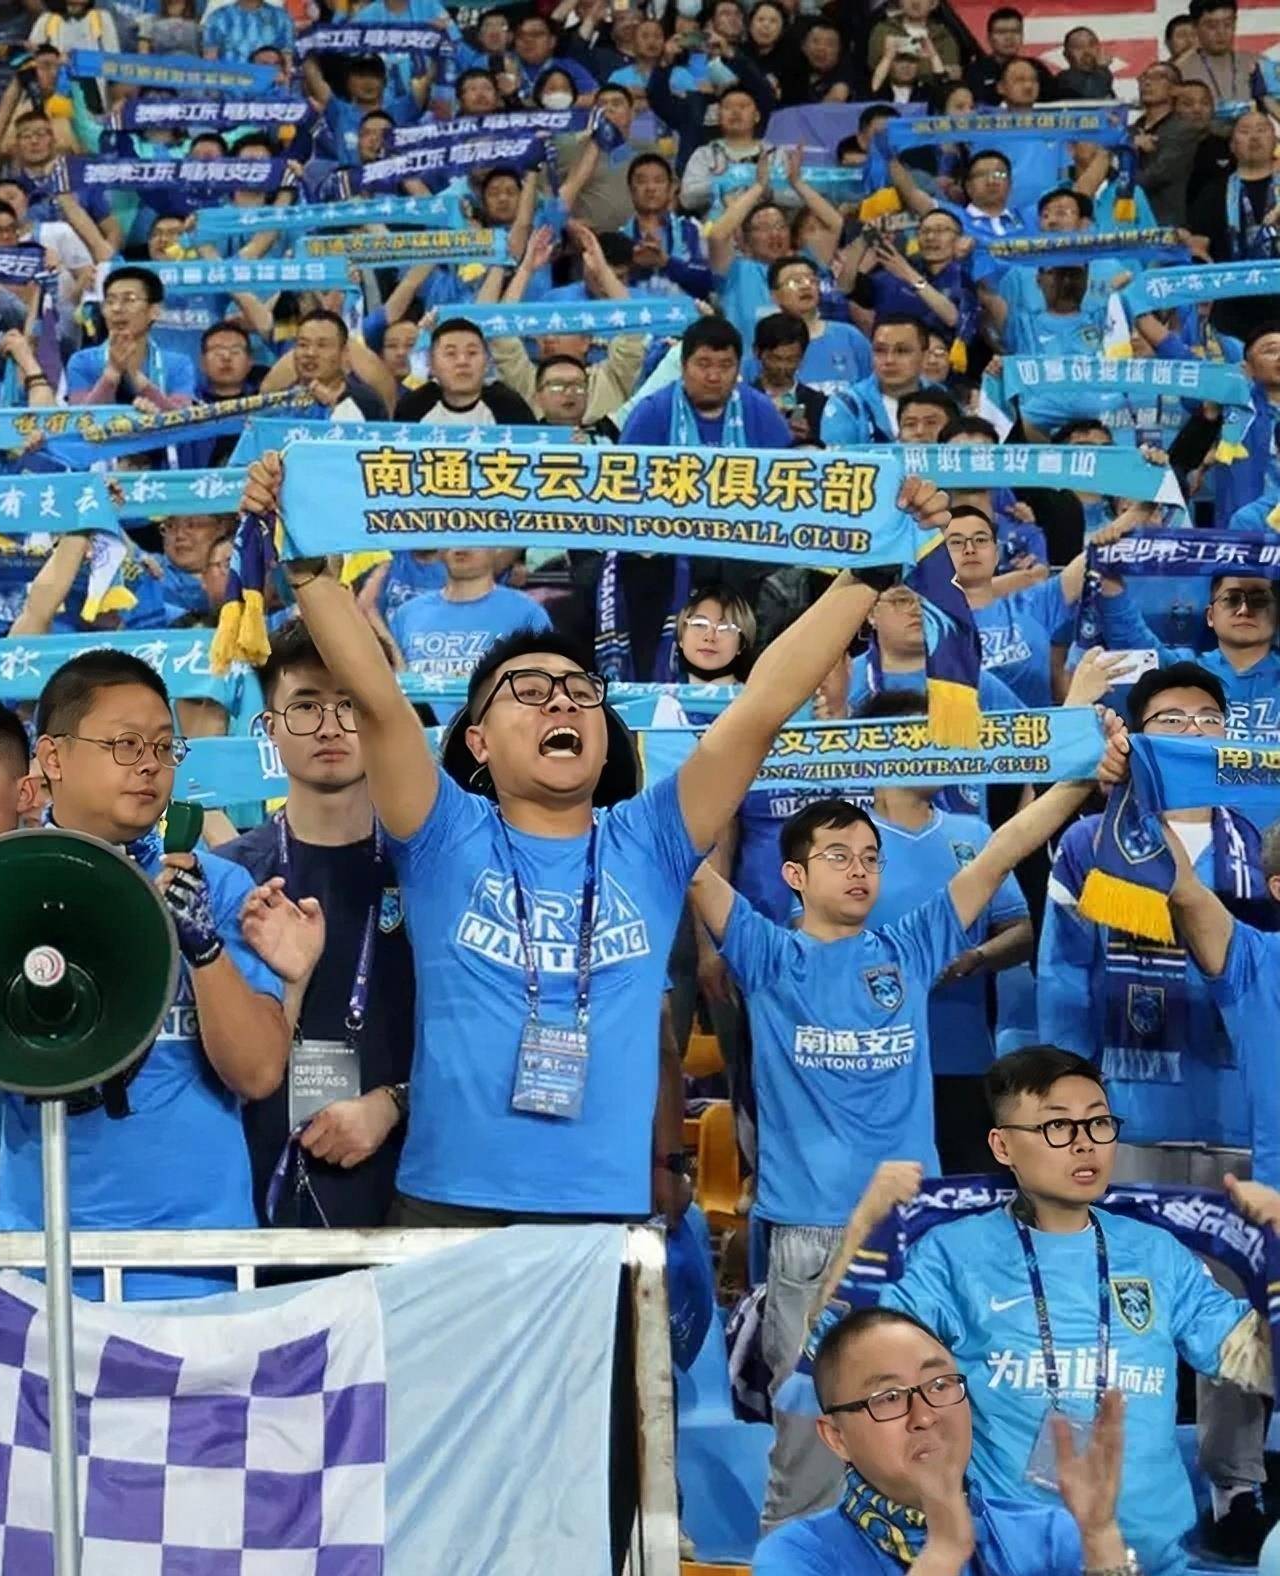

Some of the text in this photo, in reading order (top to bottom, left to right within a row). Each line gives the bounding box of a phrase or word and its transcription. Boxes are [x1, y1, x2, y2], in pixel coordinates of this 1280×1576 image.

[357, 447, 880, 516] 南通支云足球俱乐部
[365, 508, 872, 554] NANTONG ZHIYUN FOOTBALL CLUB
[883, 756, 989, 777] FOOTBALL
[993, 753, 1050, 772] CLUB
[794, 1023, 916, 1057] 南通支云
[794, 1055, 868, 1071] NANTONG
